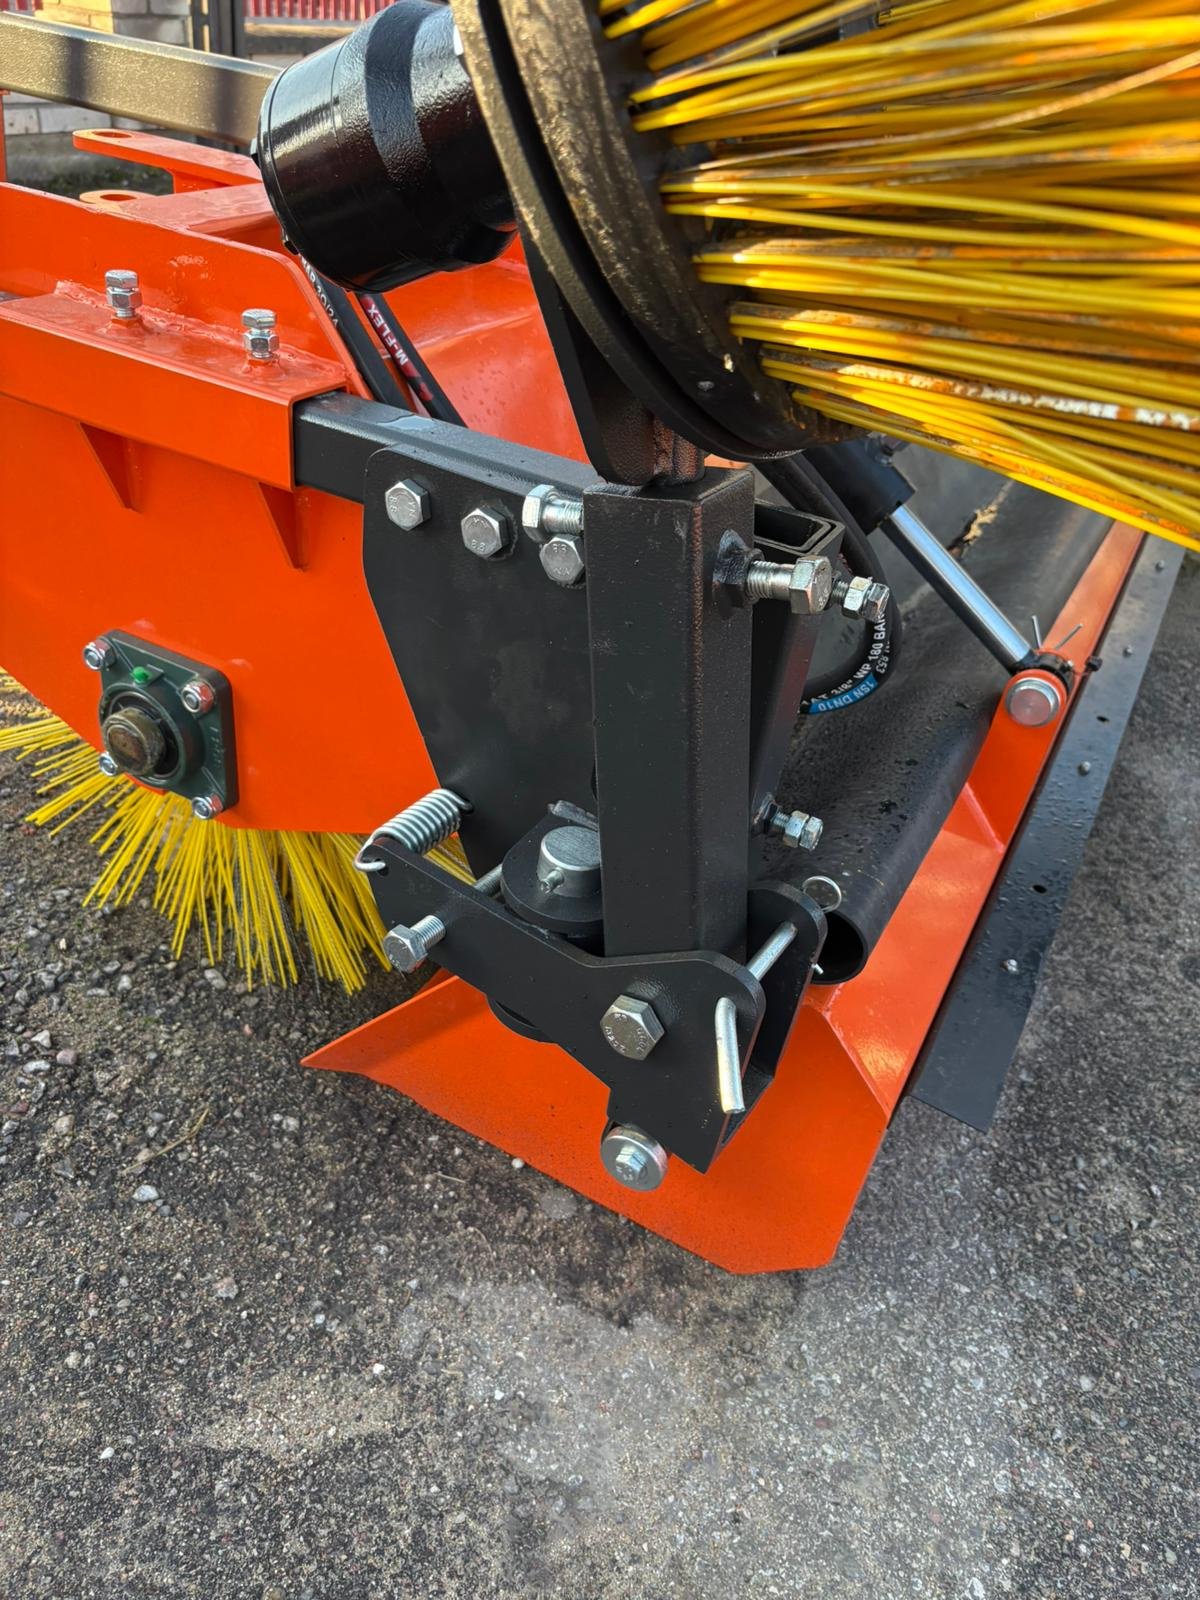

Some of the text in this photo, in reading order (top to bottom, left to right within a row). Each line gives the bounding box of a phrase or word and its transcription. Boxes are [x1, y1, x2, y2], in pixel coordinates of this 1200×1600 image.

[367, 303, 409, 366] M-FLEX
[853, 663, 872, 679] WP
[868, 643, 884, 661] 180
[818, 694, 854, 712] DN10
[853, 680, 875, 699] 1SN
